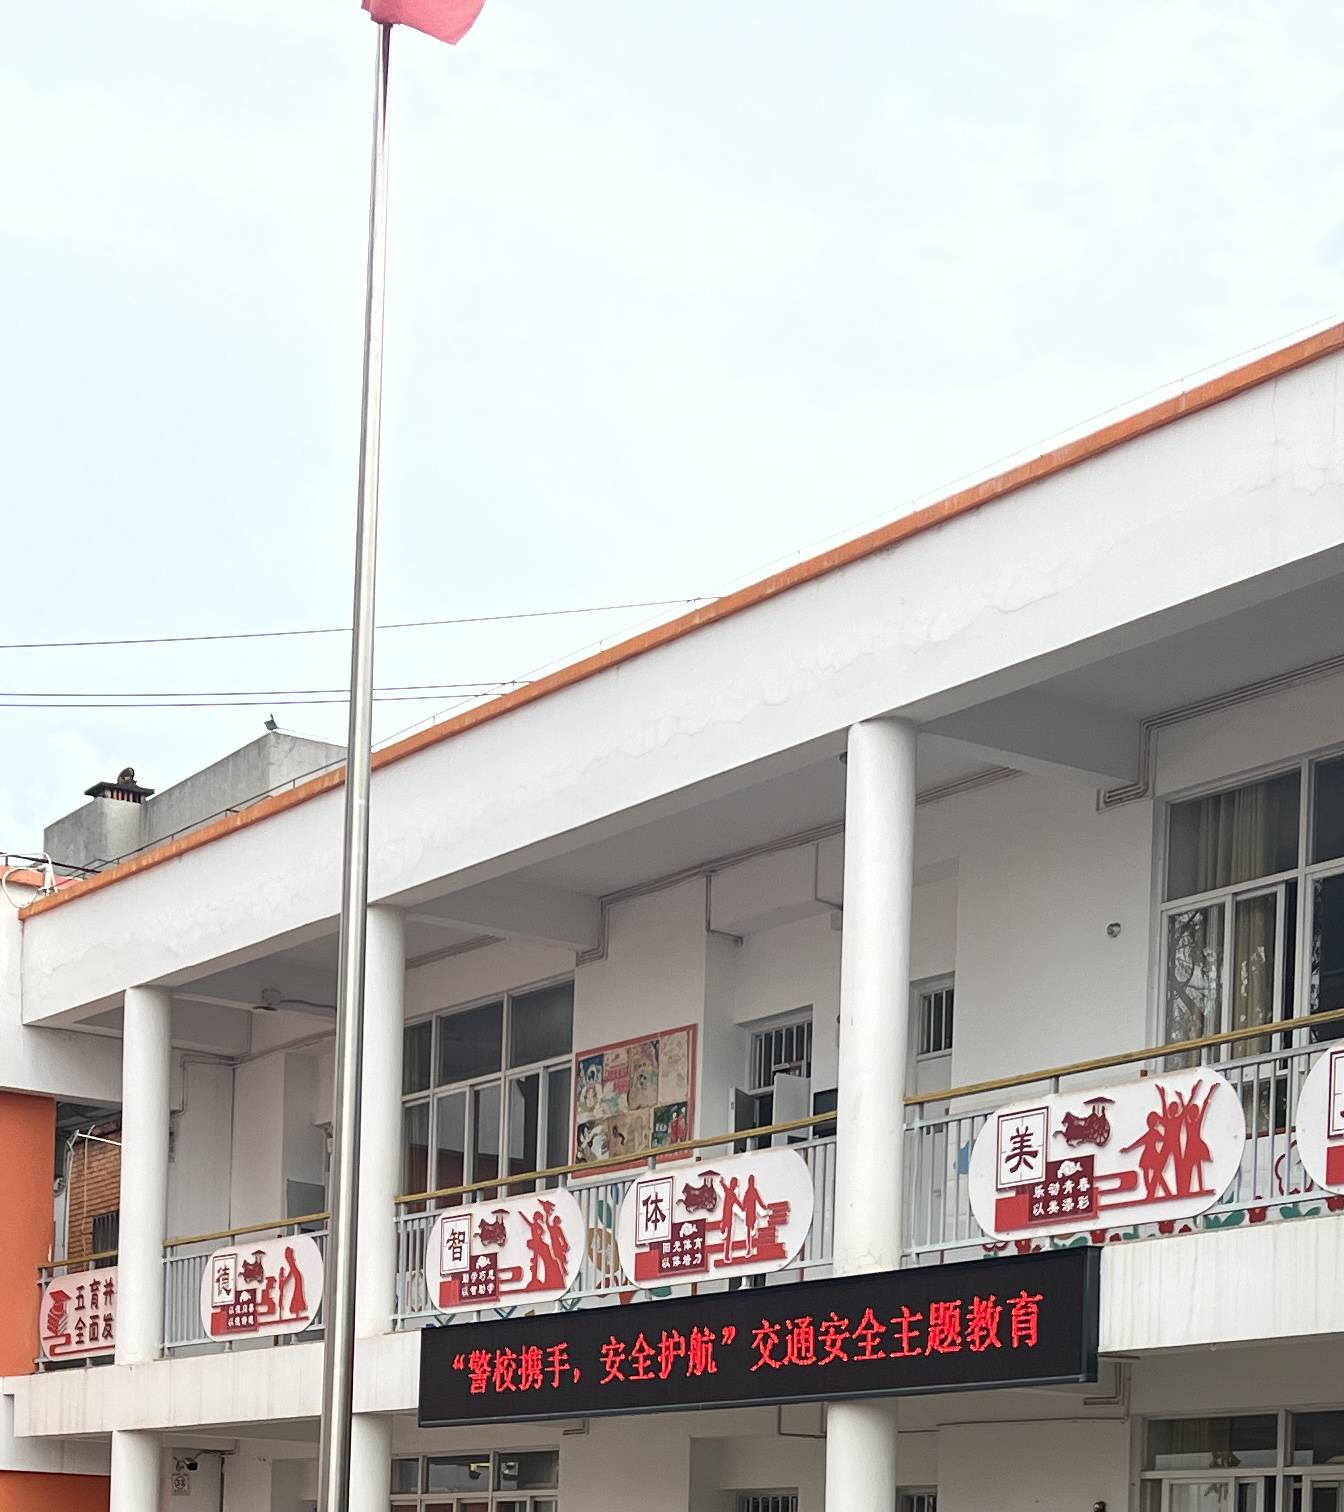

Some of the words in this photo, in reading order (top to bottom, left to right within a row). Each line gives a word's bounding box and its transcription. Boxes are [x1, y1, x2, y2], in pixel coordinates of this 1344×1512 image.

[1004, 1125, 1040, 1174] 美
[641, 1191, 667, 1232] 体
[446, 1228, 466, 1262] 智
[215, 1264, 232, 1296] 德
